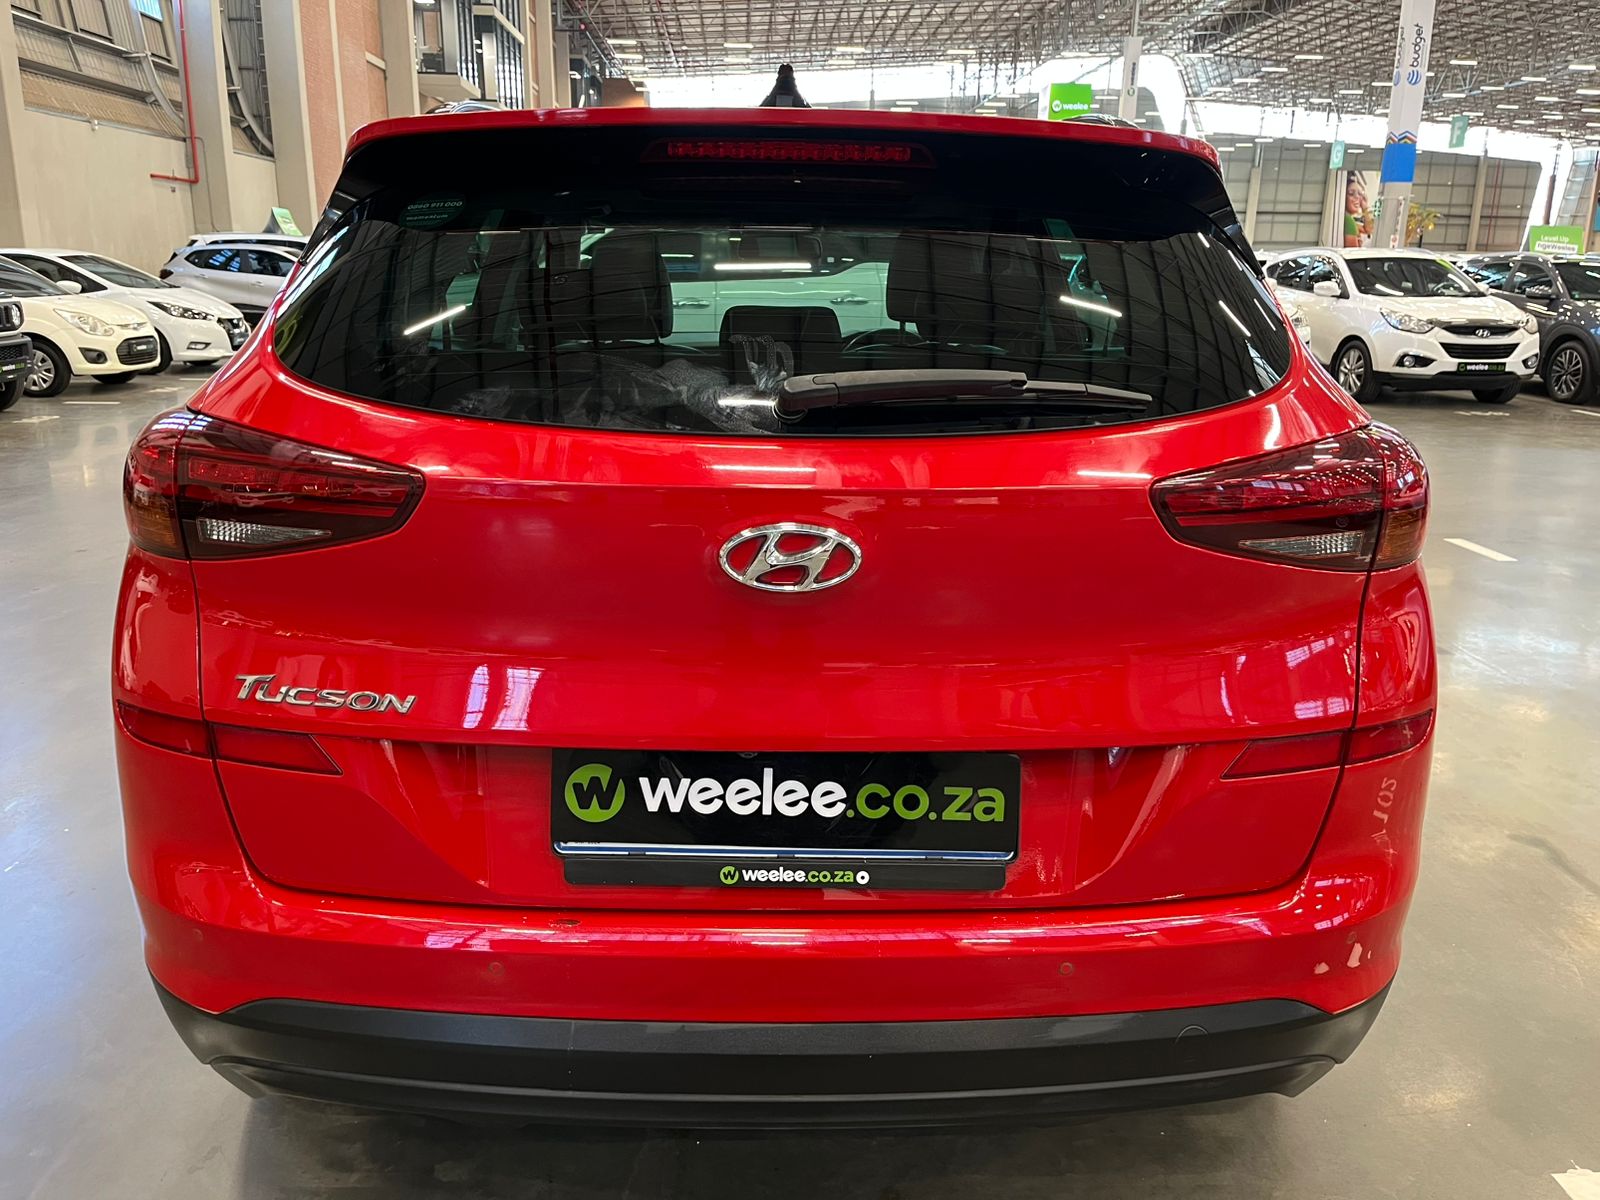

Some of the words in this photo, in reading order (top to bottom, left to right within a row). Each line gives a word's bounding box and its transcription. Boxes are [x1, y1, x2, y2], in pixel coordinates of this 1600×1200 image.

[1409, 22, 1426, 68] budget
[1062, 102, 1089, 111] weelee
[1452, 121, 1463, 145] F
[235, 674, 415, 714] TUCSON
[638, 767, 1006, 822] weelee.co.za
[742, 866, 854, 883] weelee.co.za
